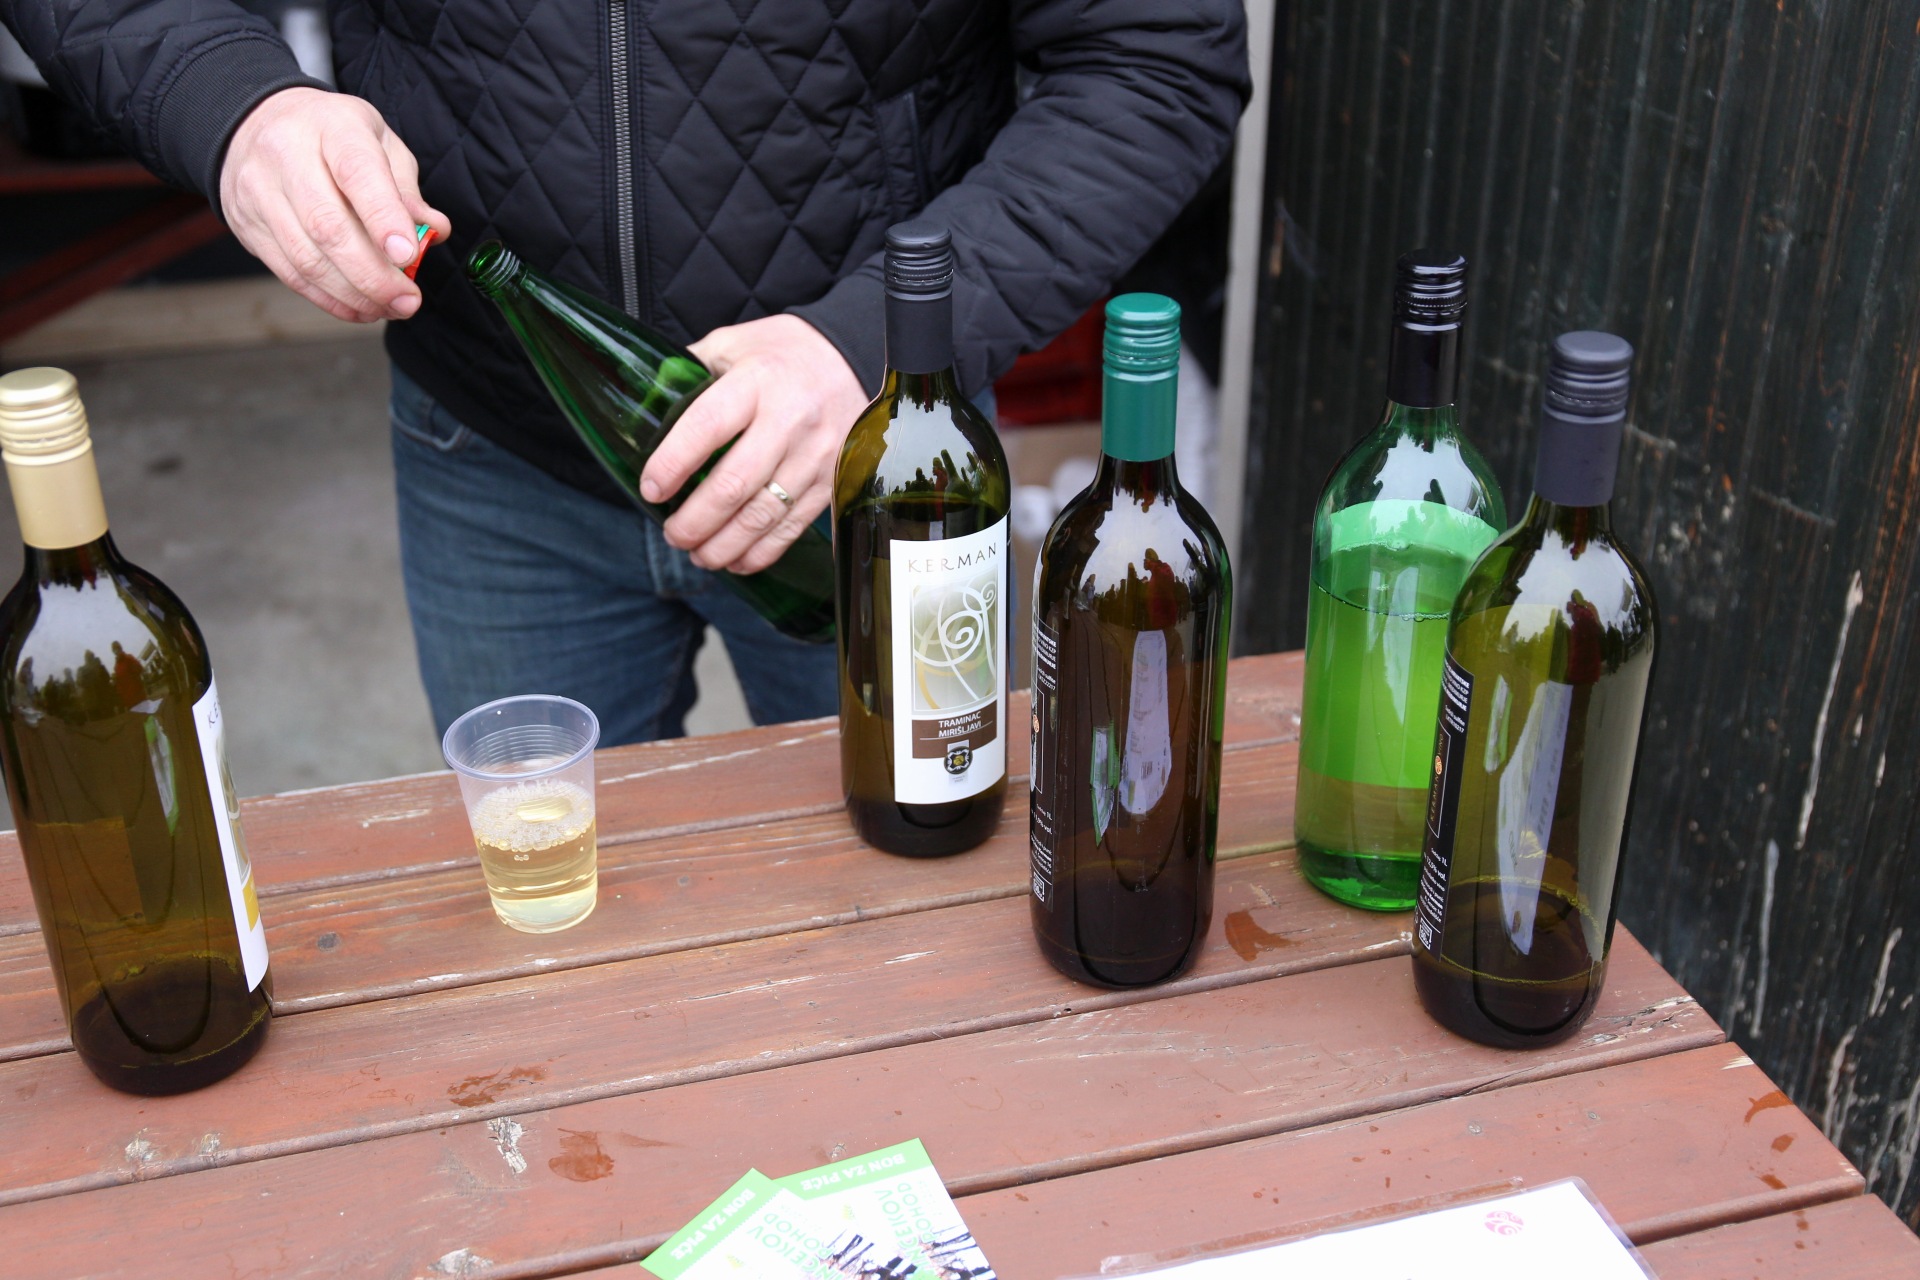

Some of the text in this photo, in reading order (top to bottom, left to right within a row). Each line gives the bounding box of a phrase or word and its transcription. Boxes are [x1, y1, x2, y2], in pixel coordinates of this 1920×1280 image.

[908, 542, 996, 573] KERMAN
[938, 711, 982, 729] TRAMINAC
[938, 720, 982, 738] MIRIŠLJAVI
[842, 1164, 866, 1180] ZA
[868, 1153, 907, 1173] BON
[722, 1188, 756, 1217] BON
[701, 1213, 727, 1232] ZA
[897, 1183, 935, 1244] POHOD
[763, 1213, 834, 1259] POHOD
